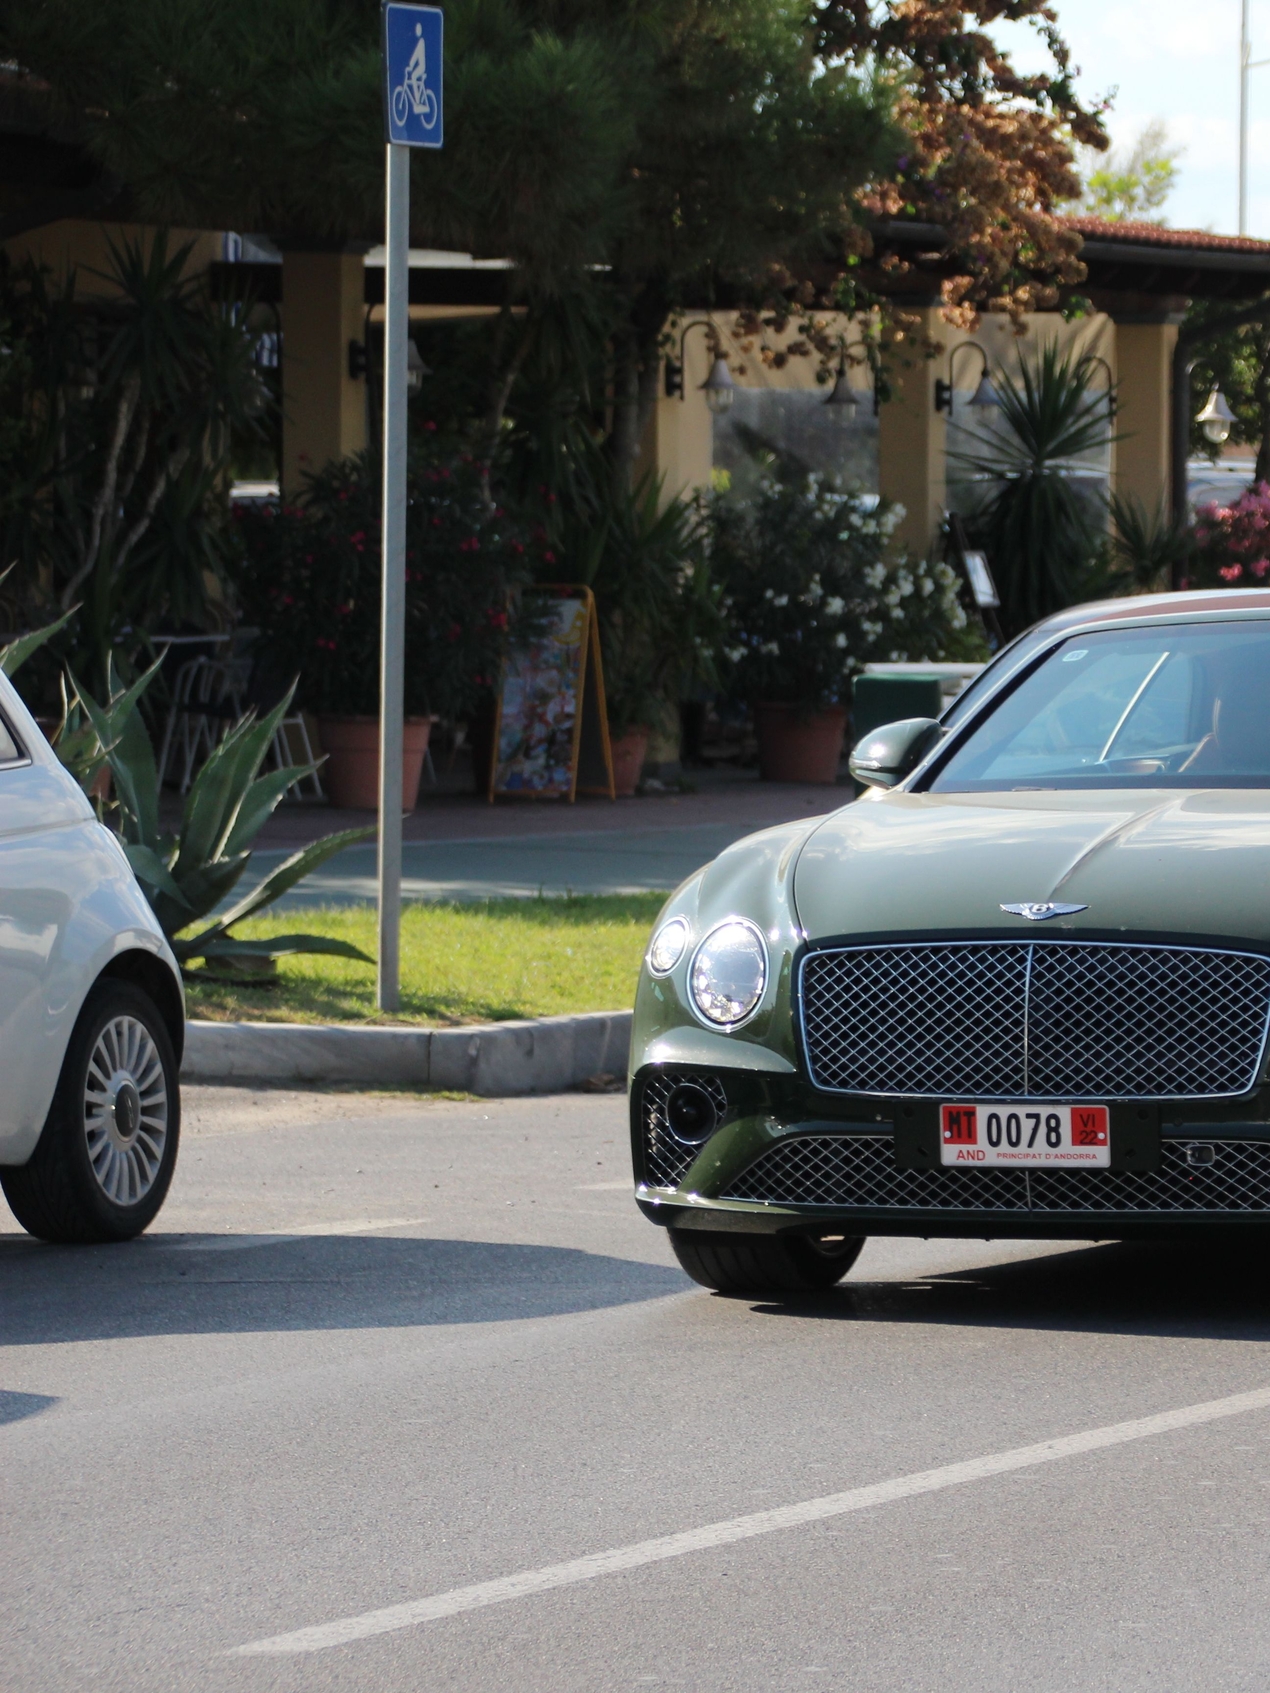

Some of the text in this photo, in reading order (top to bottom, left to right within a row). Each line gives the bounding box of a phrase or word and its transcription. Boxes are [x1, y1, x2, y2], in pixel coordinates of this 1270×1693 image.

[1079, 1114, 1095, 1127] VI
[987, 1113, 1062, 1148] 0078
[1079, 1130, 1098, 1145] 22
[956, 1150, 986, 1161] AND
